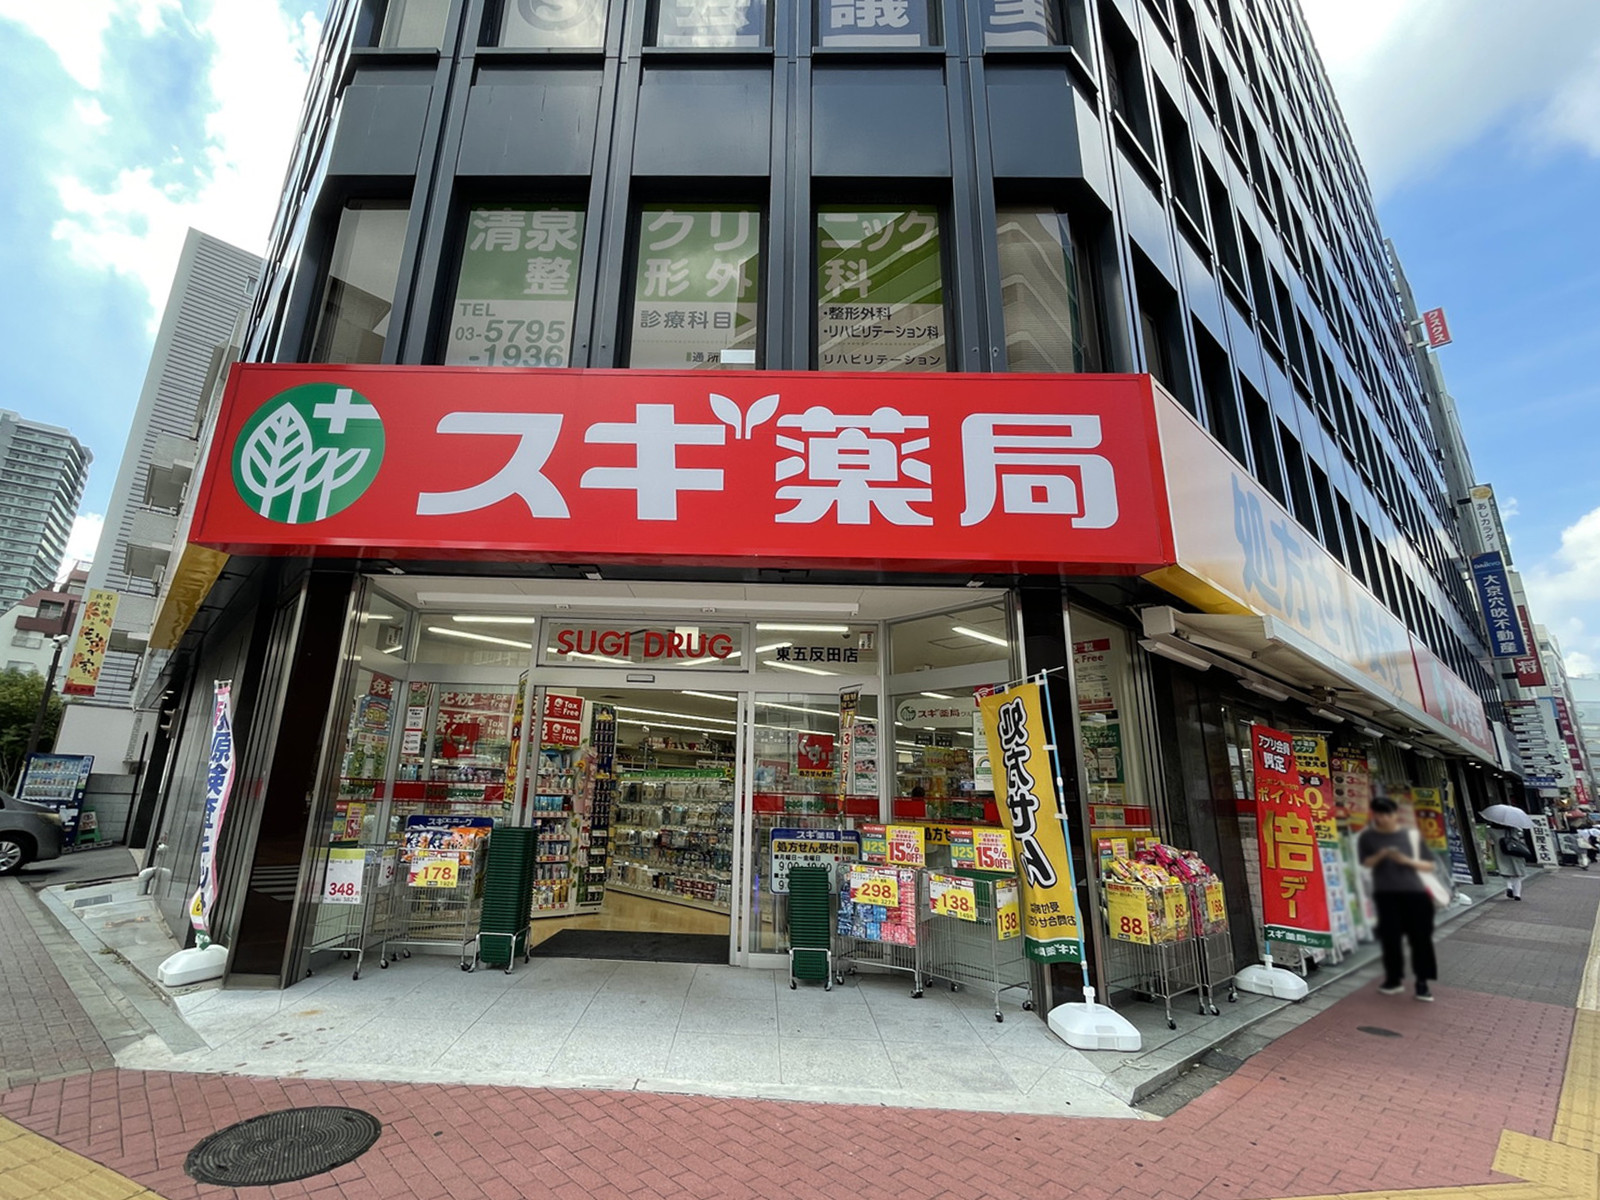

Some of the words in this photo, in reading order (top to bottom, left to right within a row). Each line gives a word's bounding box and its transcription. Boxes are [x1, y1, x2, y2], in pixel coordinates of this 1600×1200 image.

[469, 208, 578, 251] 清泉
[649, 208, 750, 251] クリ
[821, 210, 936, 252] ニック
[523, 256, 573, 295] 整
[643, 257, 752, 298] 形外
[824, 258, 872, 298] 科
[459, 303, 496, 317] TEL
[640, 310, 732, 330] 診療科目
[823, 354, 941, 366] リハビリテーション
[416, 393, 1119, 530] スギ薬局
[1482, 574, 1518, 654] 大京穴吹不動産
[556, 629, 631, 657] SUGI
[643, 631, 733, 659] DRUG
[776, 645, 859, 663] 東五反田店
[562, 708, 579, 716] Free
[487, 727, 506, 736] Free
[488, 718, 504, 728] Tax
[562, 726, 576, 734] Tax
[561, 733, 578, 742] Free
[1257, 734, 1291, 756] アプリ会員
[1263, 751, 1287, 774] 限定
[796, 829, 836, 840] スギ薬局
[863, 842, 886, 853] U25
[888, 841, 920, 863] 15%
[951, 846, 974, 858] U25
[976, 846, 1008, 869] 15%
